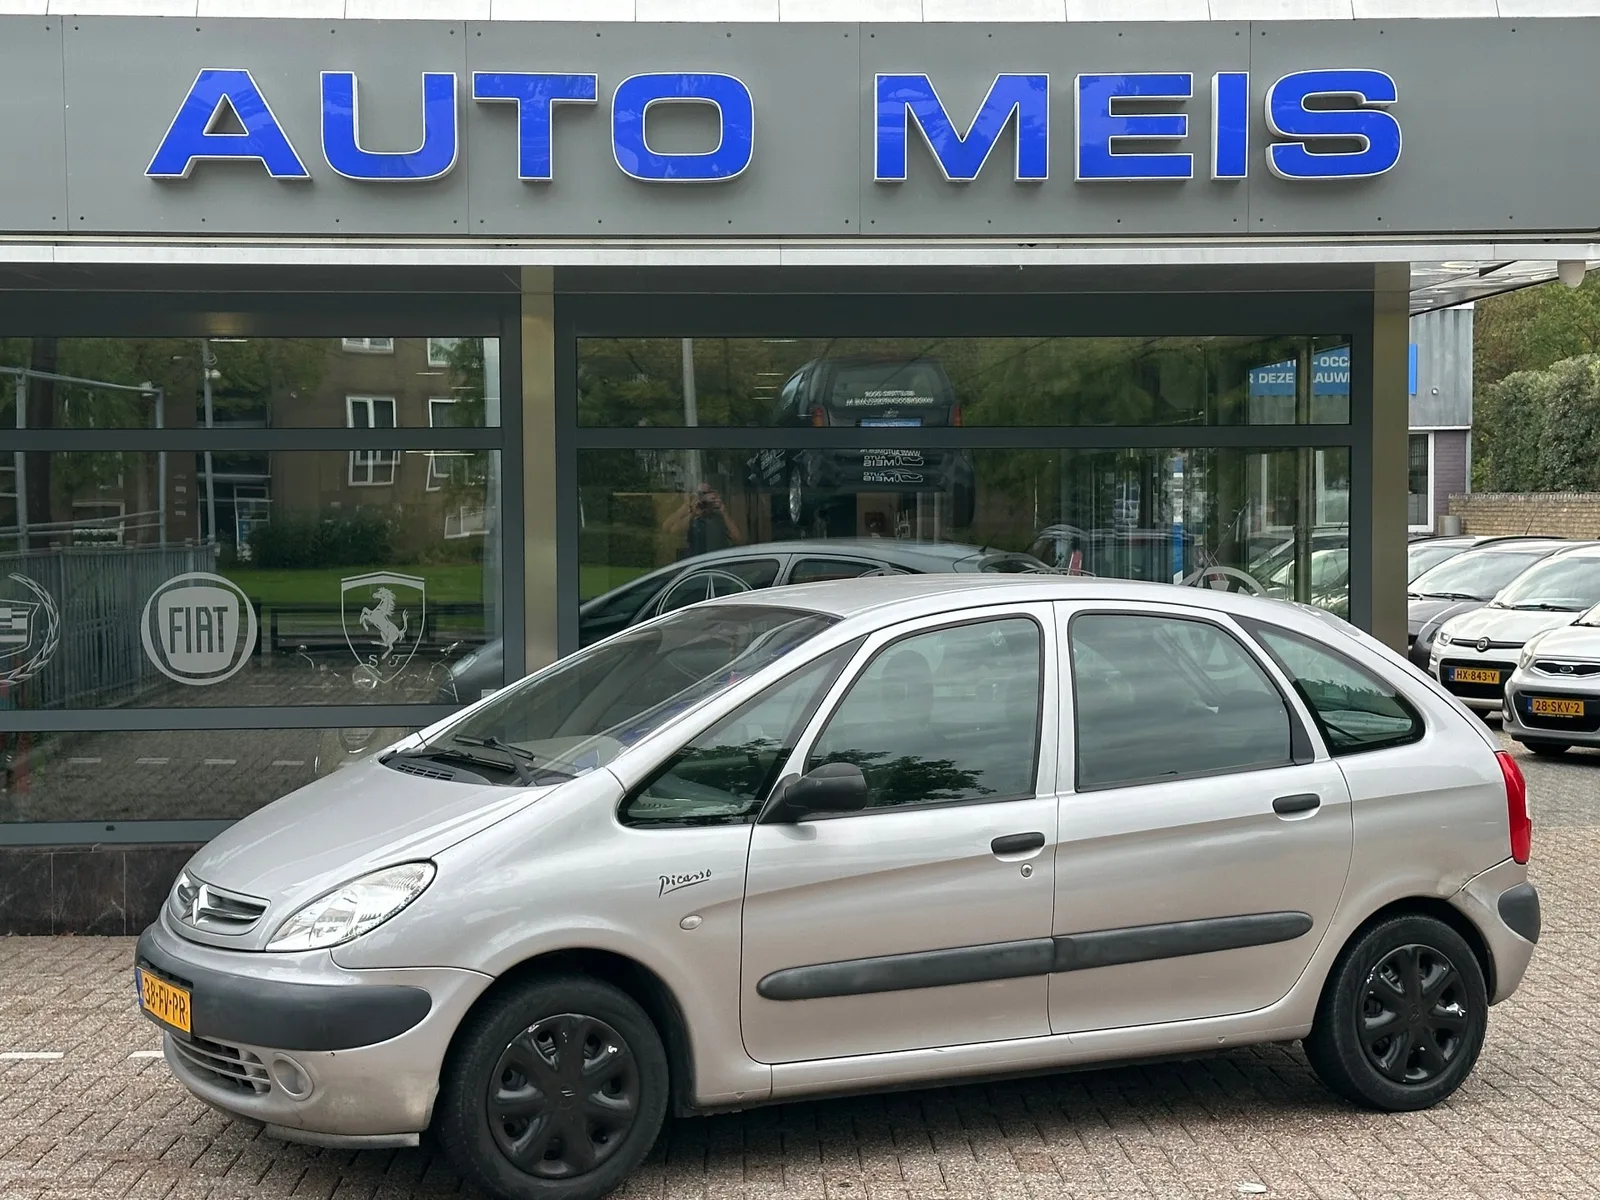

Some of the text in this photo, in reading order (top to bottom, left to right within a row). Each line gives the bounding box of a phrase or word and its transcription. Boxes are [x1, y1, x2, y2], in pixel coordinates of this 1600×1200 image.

[143, 67, 1403, 183] AUTO MEIS
[1258, 372, 1294, 384] DEZE
[168, 605, 229, 655] FIAT
[1456, 669, 1497, 683] HX-843-V
[1535, 699, 1580, 714] 28-SKV-2
[658, 868, 712, 899] Picasso
[144, 977, 187, 1027] 38-FV-PR
